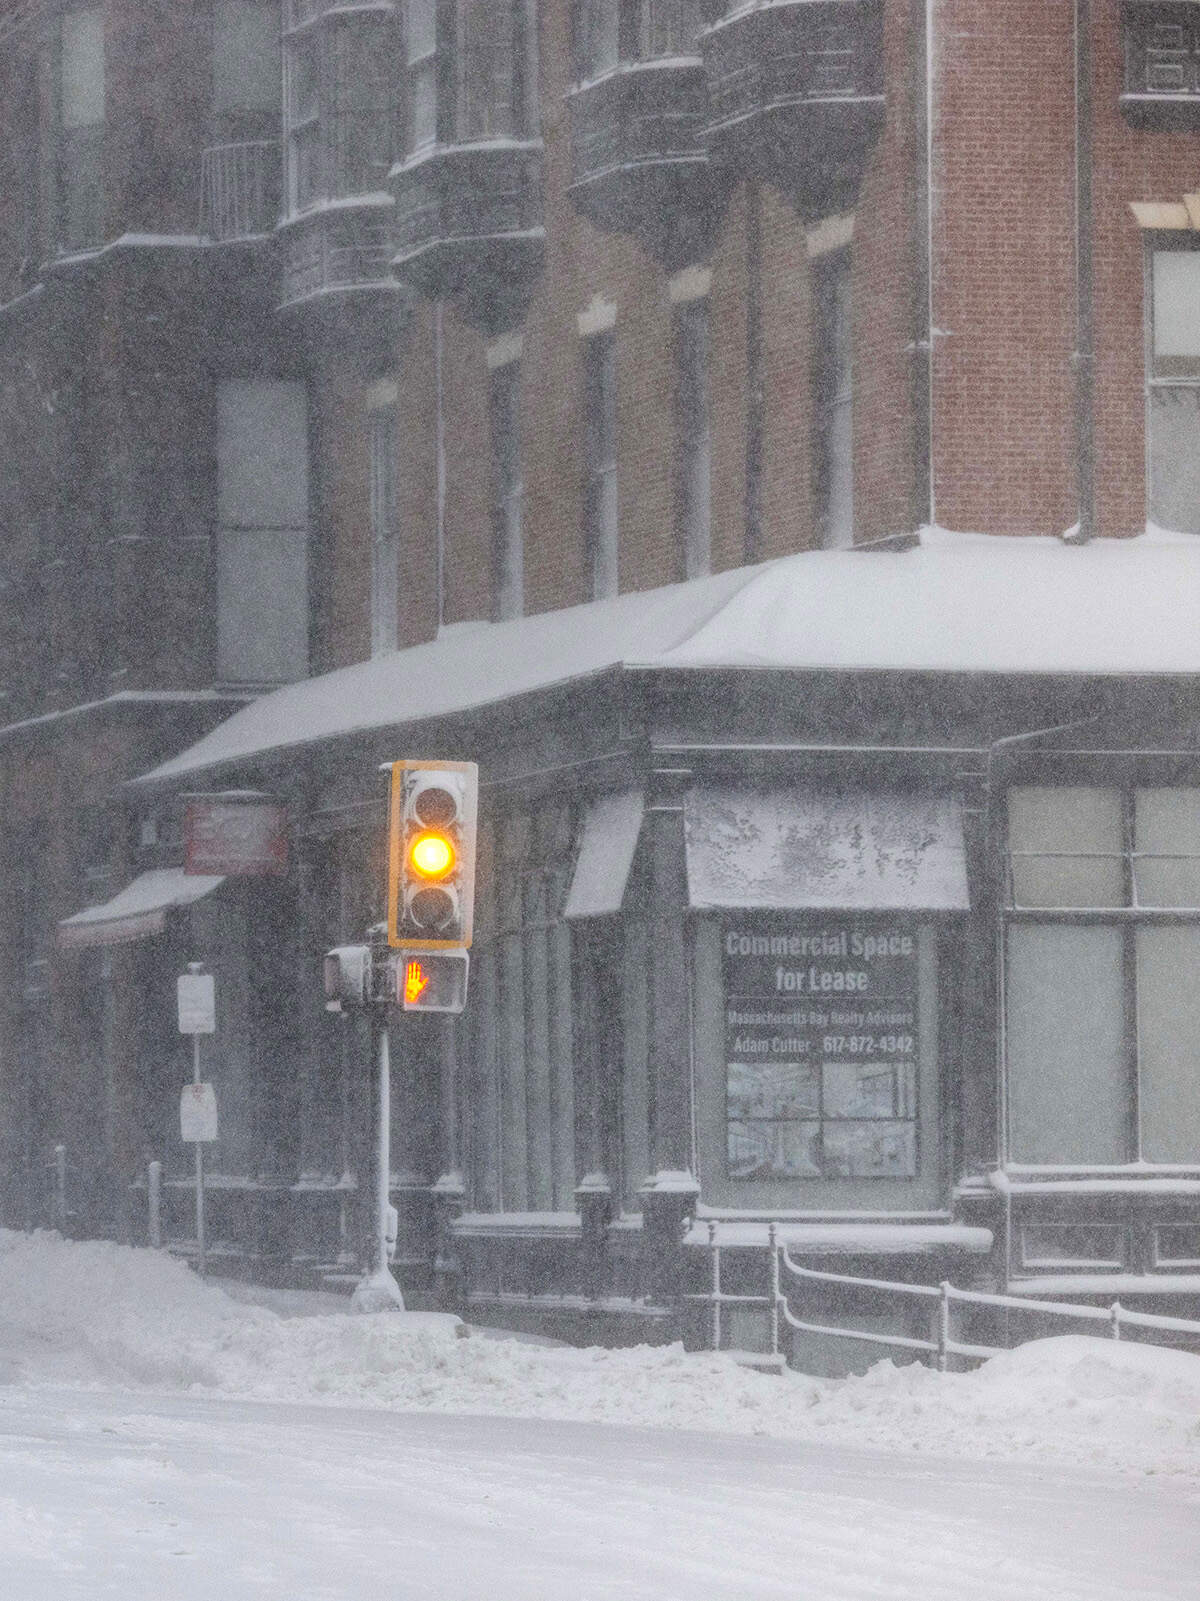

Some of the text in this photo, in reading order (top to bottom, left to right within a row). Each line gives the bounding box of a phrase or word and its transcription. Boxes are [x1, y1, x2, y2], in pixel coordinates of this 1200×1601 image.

[726, 931, 914, 962] Commercial Space
[775, 966, 870, 991] for Lease
[809, 1010, 830, 1028] Bay
[734, 1035, 914, 1053] Adam Cutter 617-872-4342
